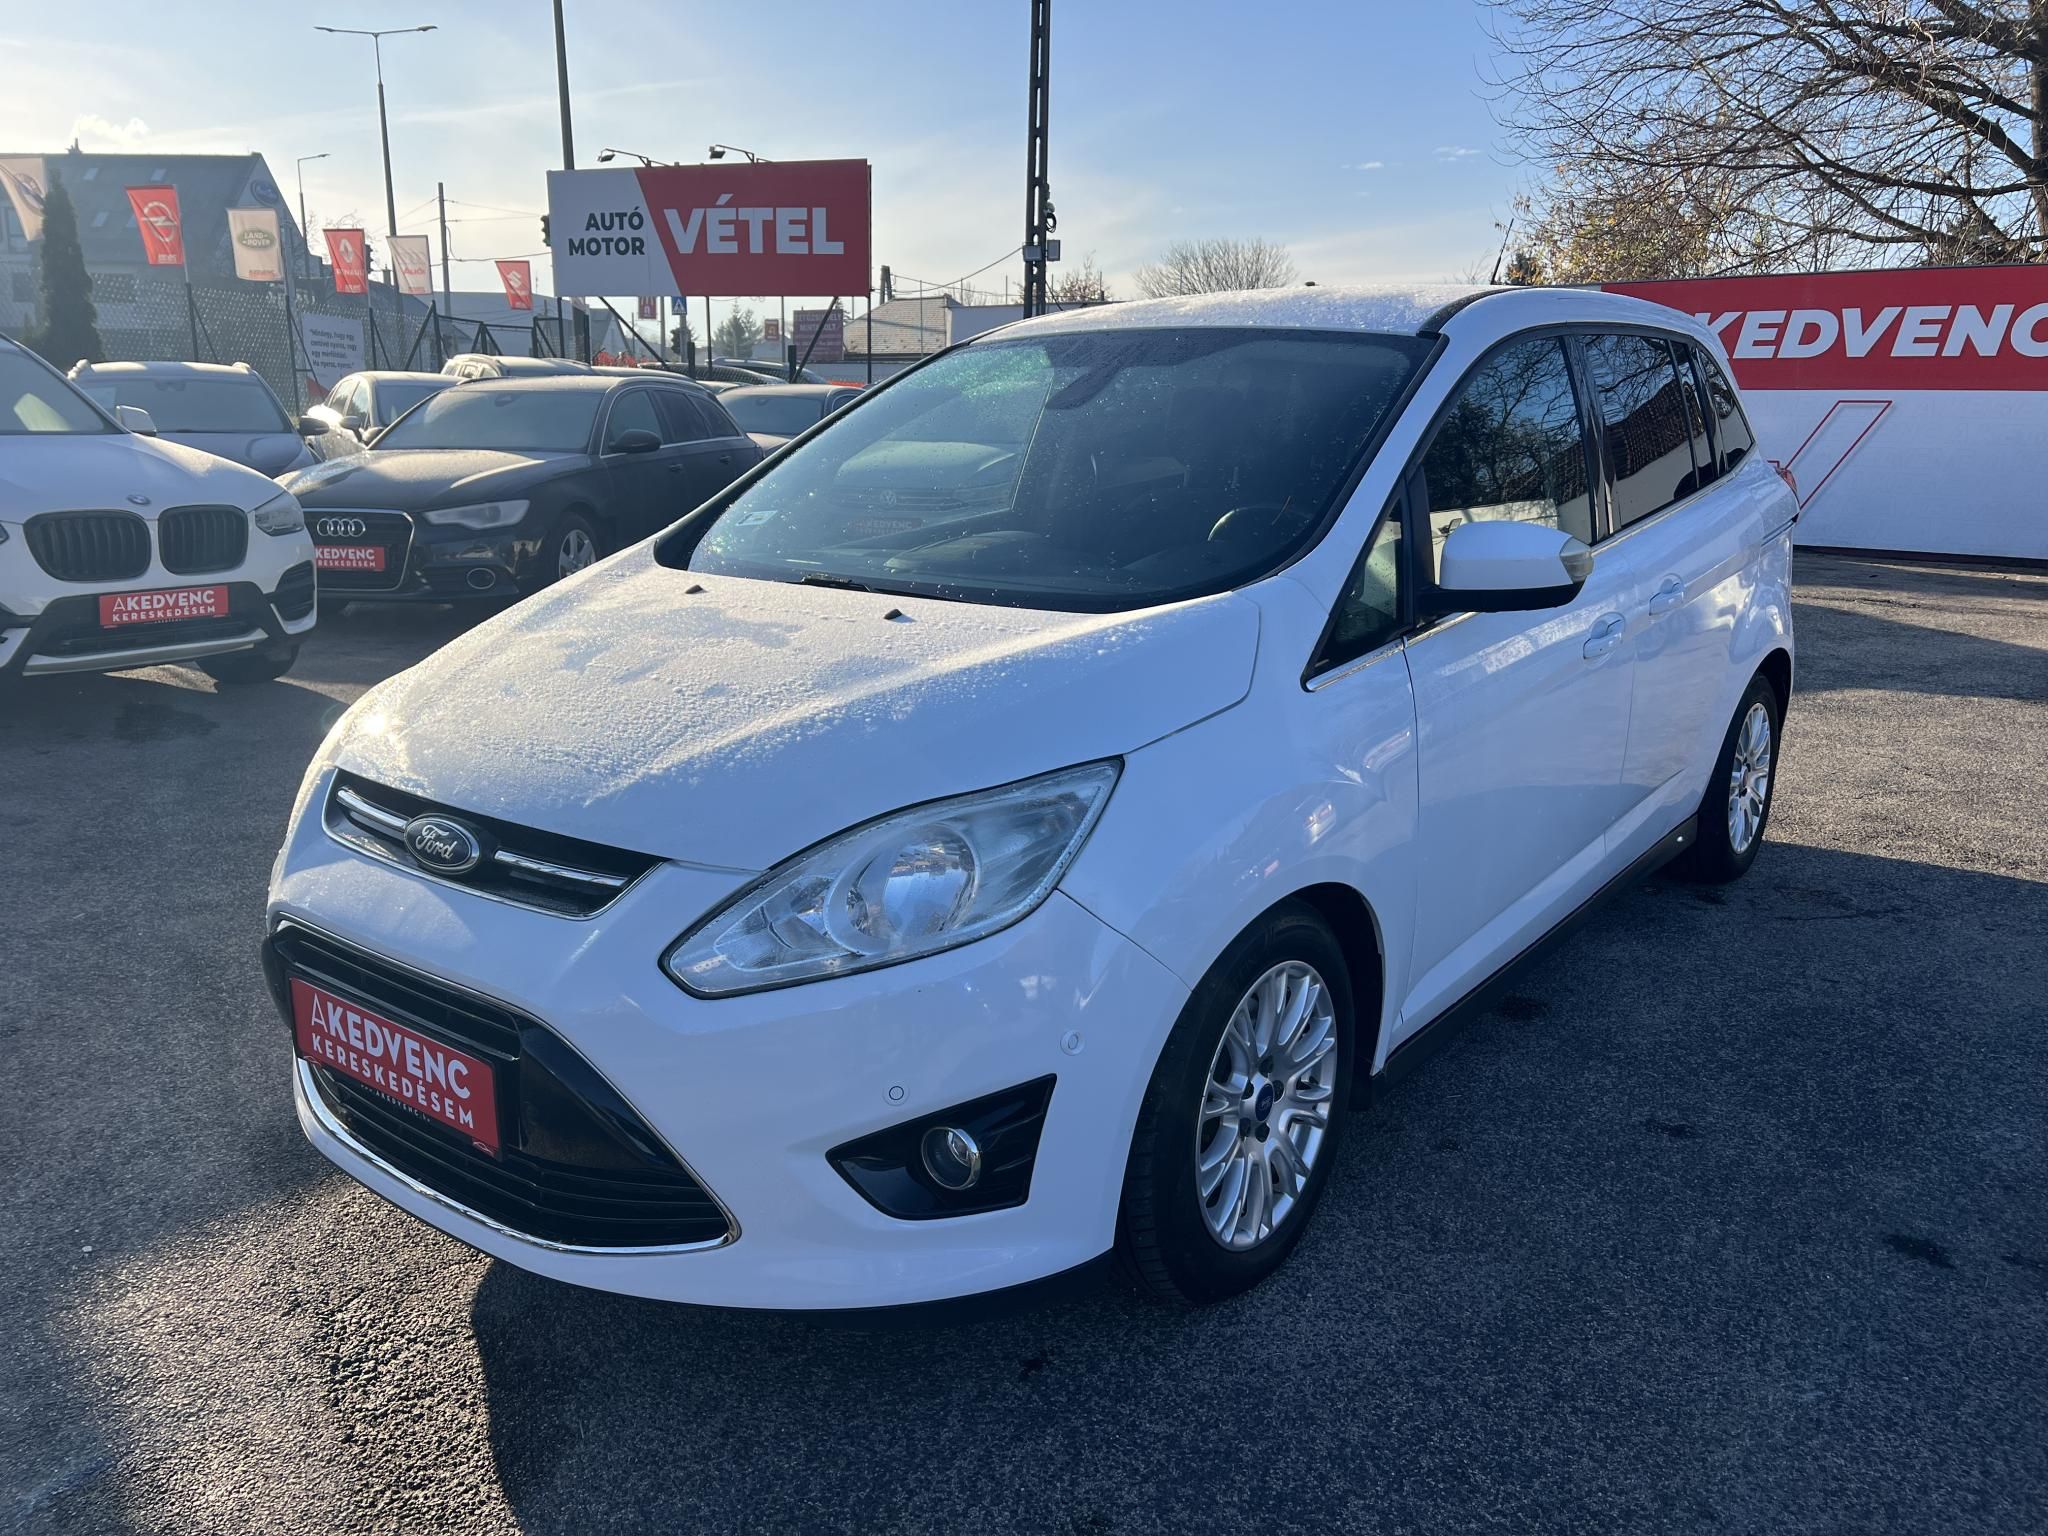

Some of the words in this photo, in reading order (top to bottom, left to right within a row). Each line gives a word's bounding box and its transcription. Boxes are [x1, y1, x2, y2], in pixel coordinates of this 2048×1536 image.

[585, 206, 644, 231] AUTÓ
[664, 193, 844, 255] VÉTEL
[568, 236, 645, 256] MOTOR
[112, 590, 215, 612] AKEDVENC
[112, 605, 215, 622] KERESKEDÉSEM
[415, 824, 456, 860] Ford
[311, 992, 471, 1100] AKEDVENC
[312, 1033, 474, 1130] KERESKEDÉSEM
